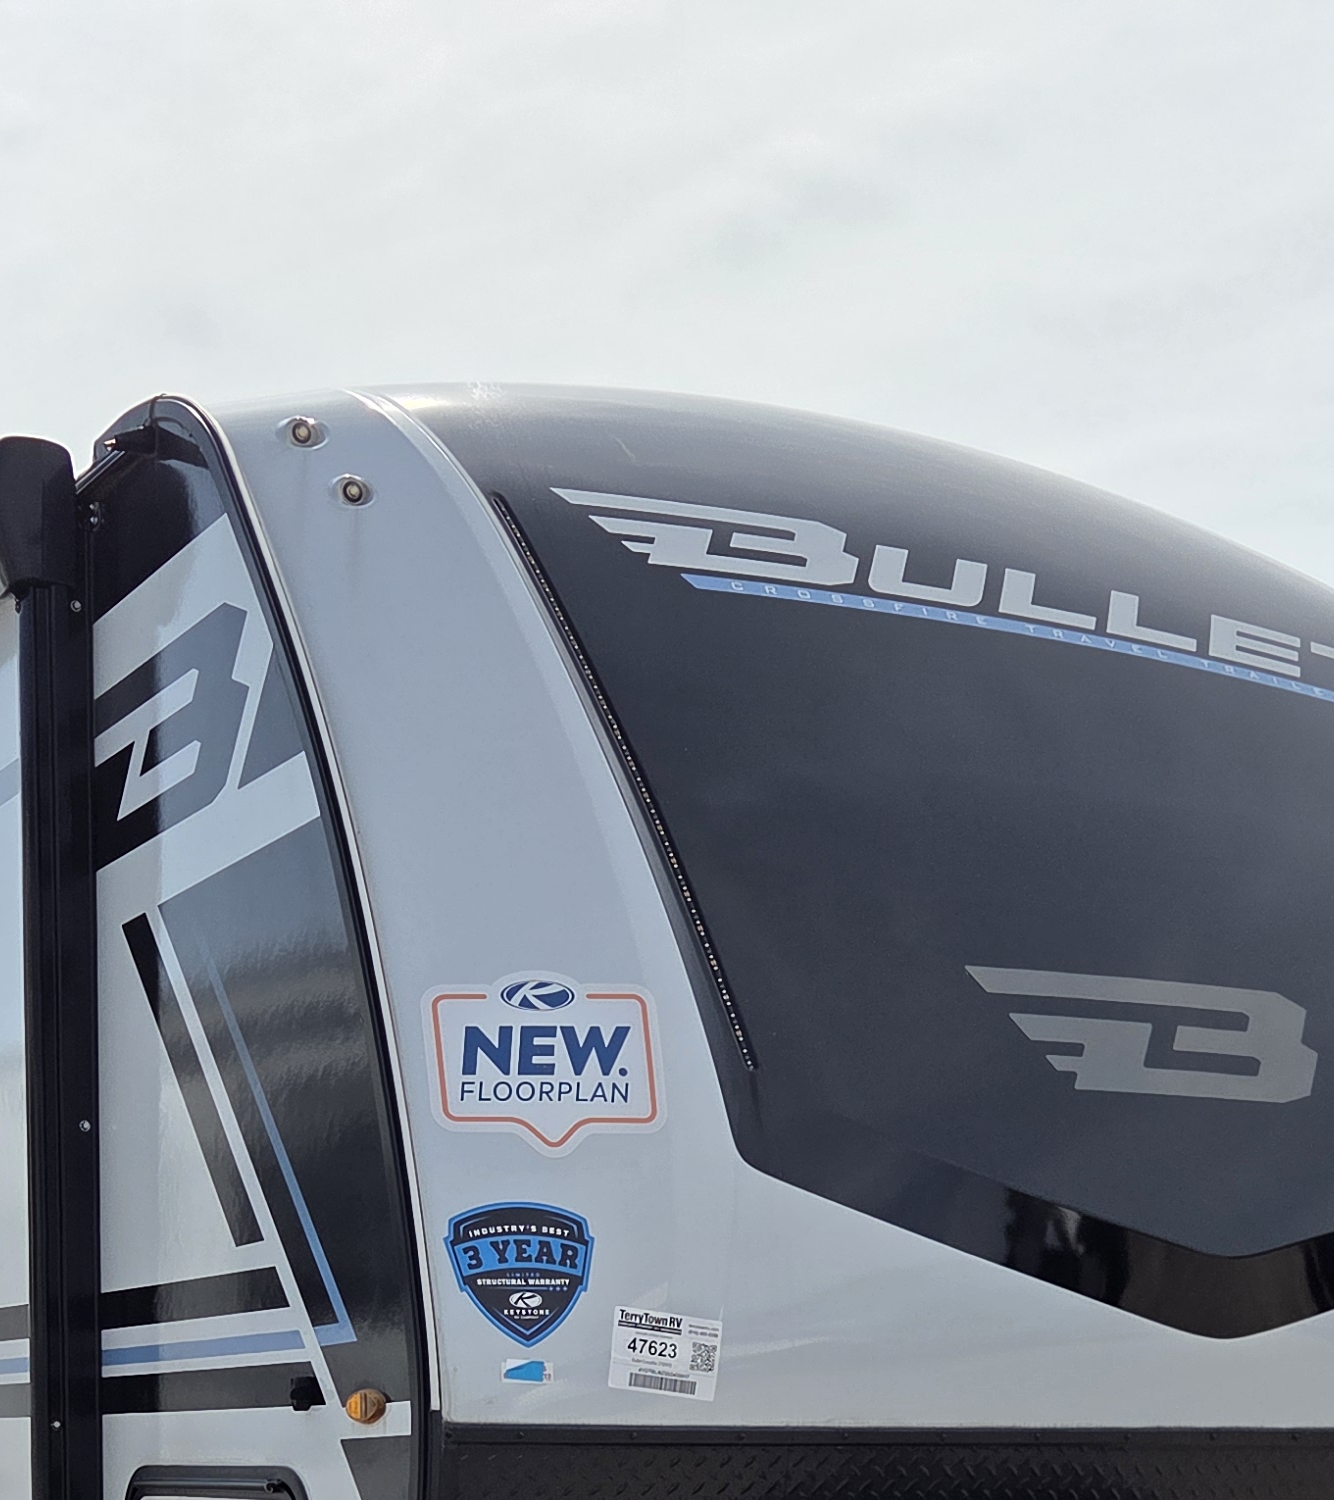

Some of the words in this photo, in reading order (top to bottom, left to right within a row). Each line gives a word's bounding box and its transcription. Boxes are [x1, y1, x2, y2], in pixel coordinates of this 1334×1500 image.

[730, 580, 988, 626] CROSSFIRE
[1024, 623, 1168, 660] TRAVEL
[461, 1025, 631, 1077] NEW.
[460, 1080, 629, 1103] FLOORPLAN
[468, 1225, 537, 1238] INDUSTRY'S
[541, 1226, 570, 1237] BEST
[462, 1245, 484, 1270] 3
[490, 1239, 579, 1270] YEAR
[476, 1278, 526, 1286] STRUCTURAL
[527, 1278, 570, 1286] WARRANTY
[627, 1337, 678, 1359] 47623
